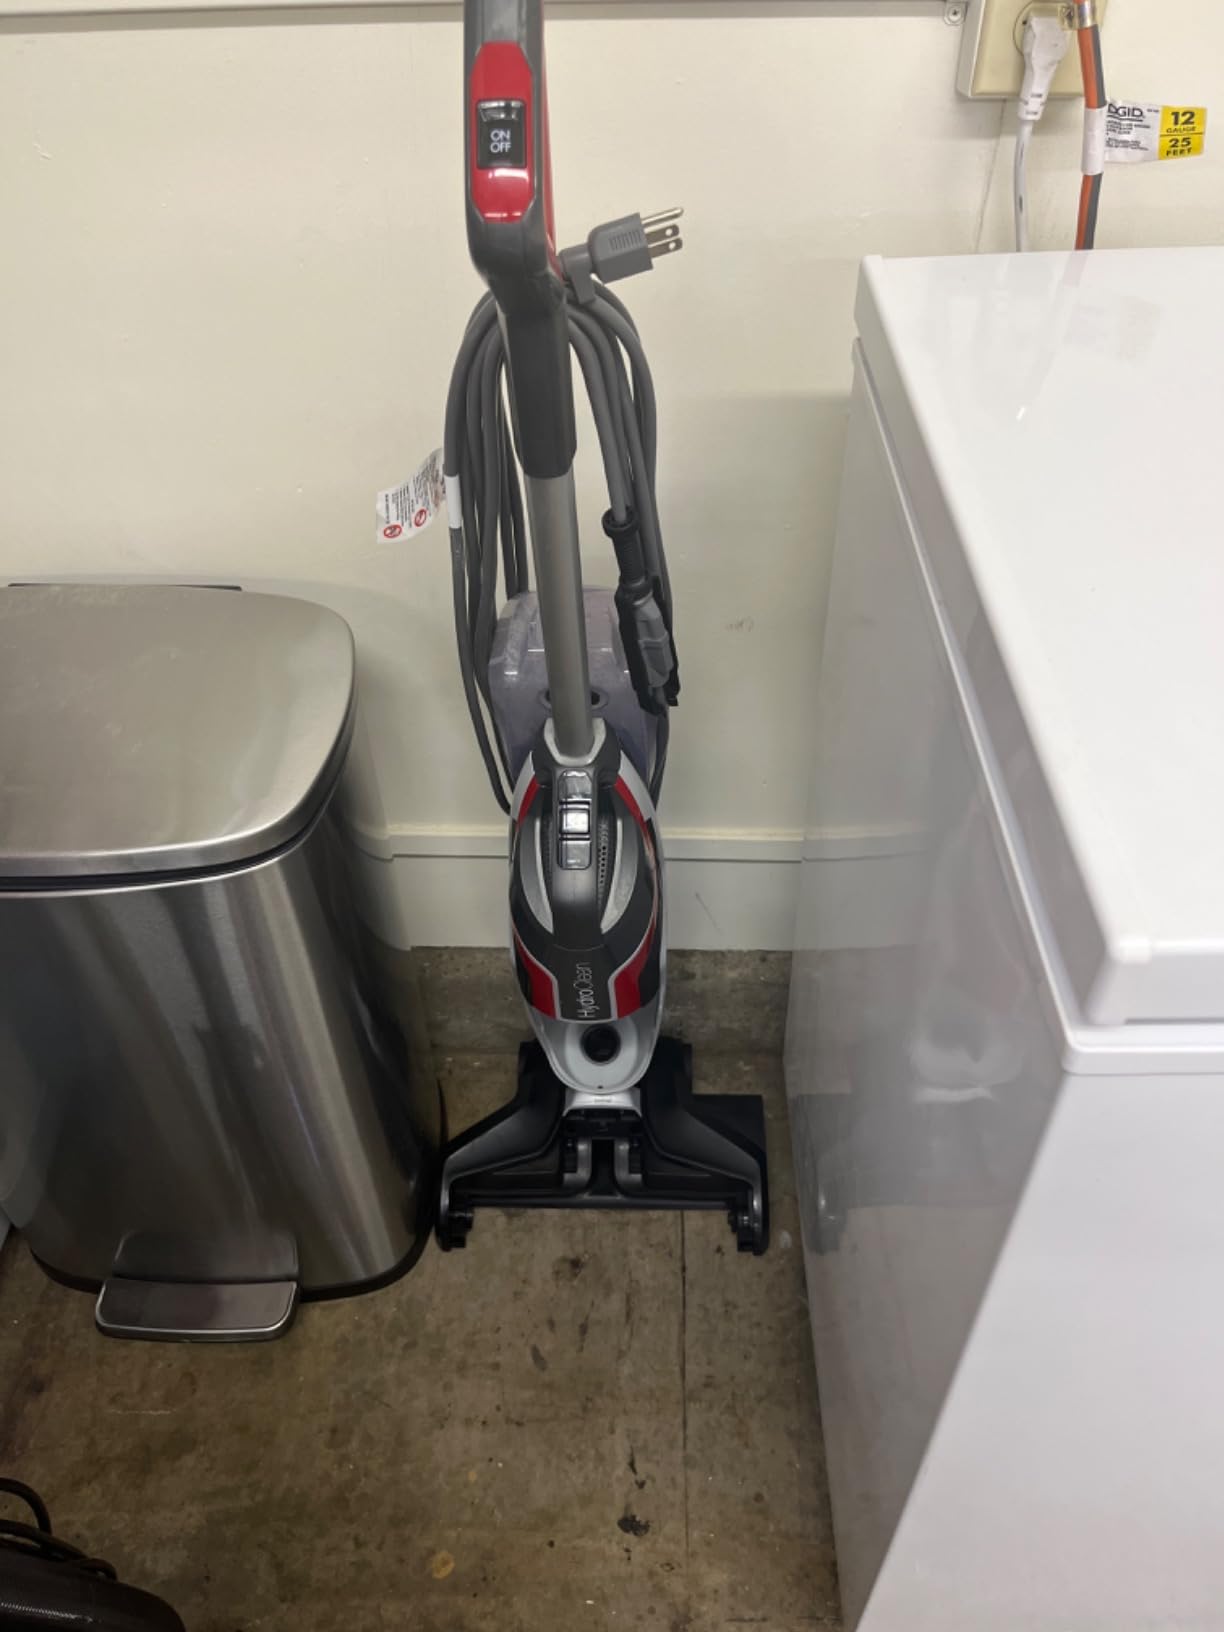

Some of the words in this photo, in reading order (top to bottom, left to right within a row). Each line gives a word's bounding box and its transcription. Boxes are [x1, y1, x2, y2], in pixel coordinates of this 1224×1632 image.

[1107, 103, 1144, 118] DGID
[1171, 110, 1196, 126] 12
[490, 129, 511, 141] ON
[1166, 126, 1196, 134] GAUGE
[490, 142, 511, 153] OFF
[1168, 137, 1192, 148] 25
[1166, 148, 1193, 157] FEET
